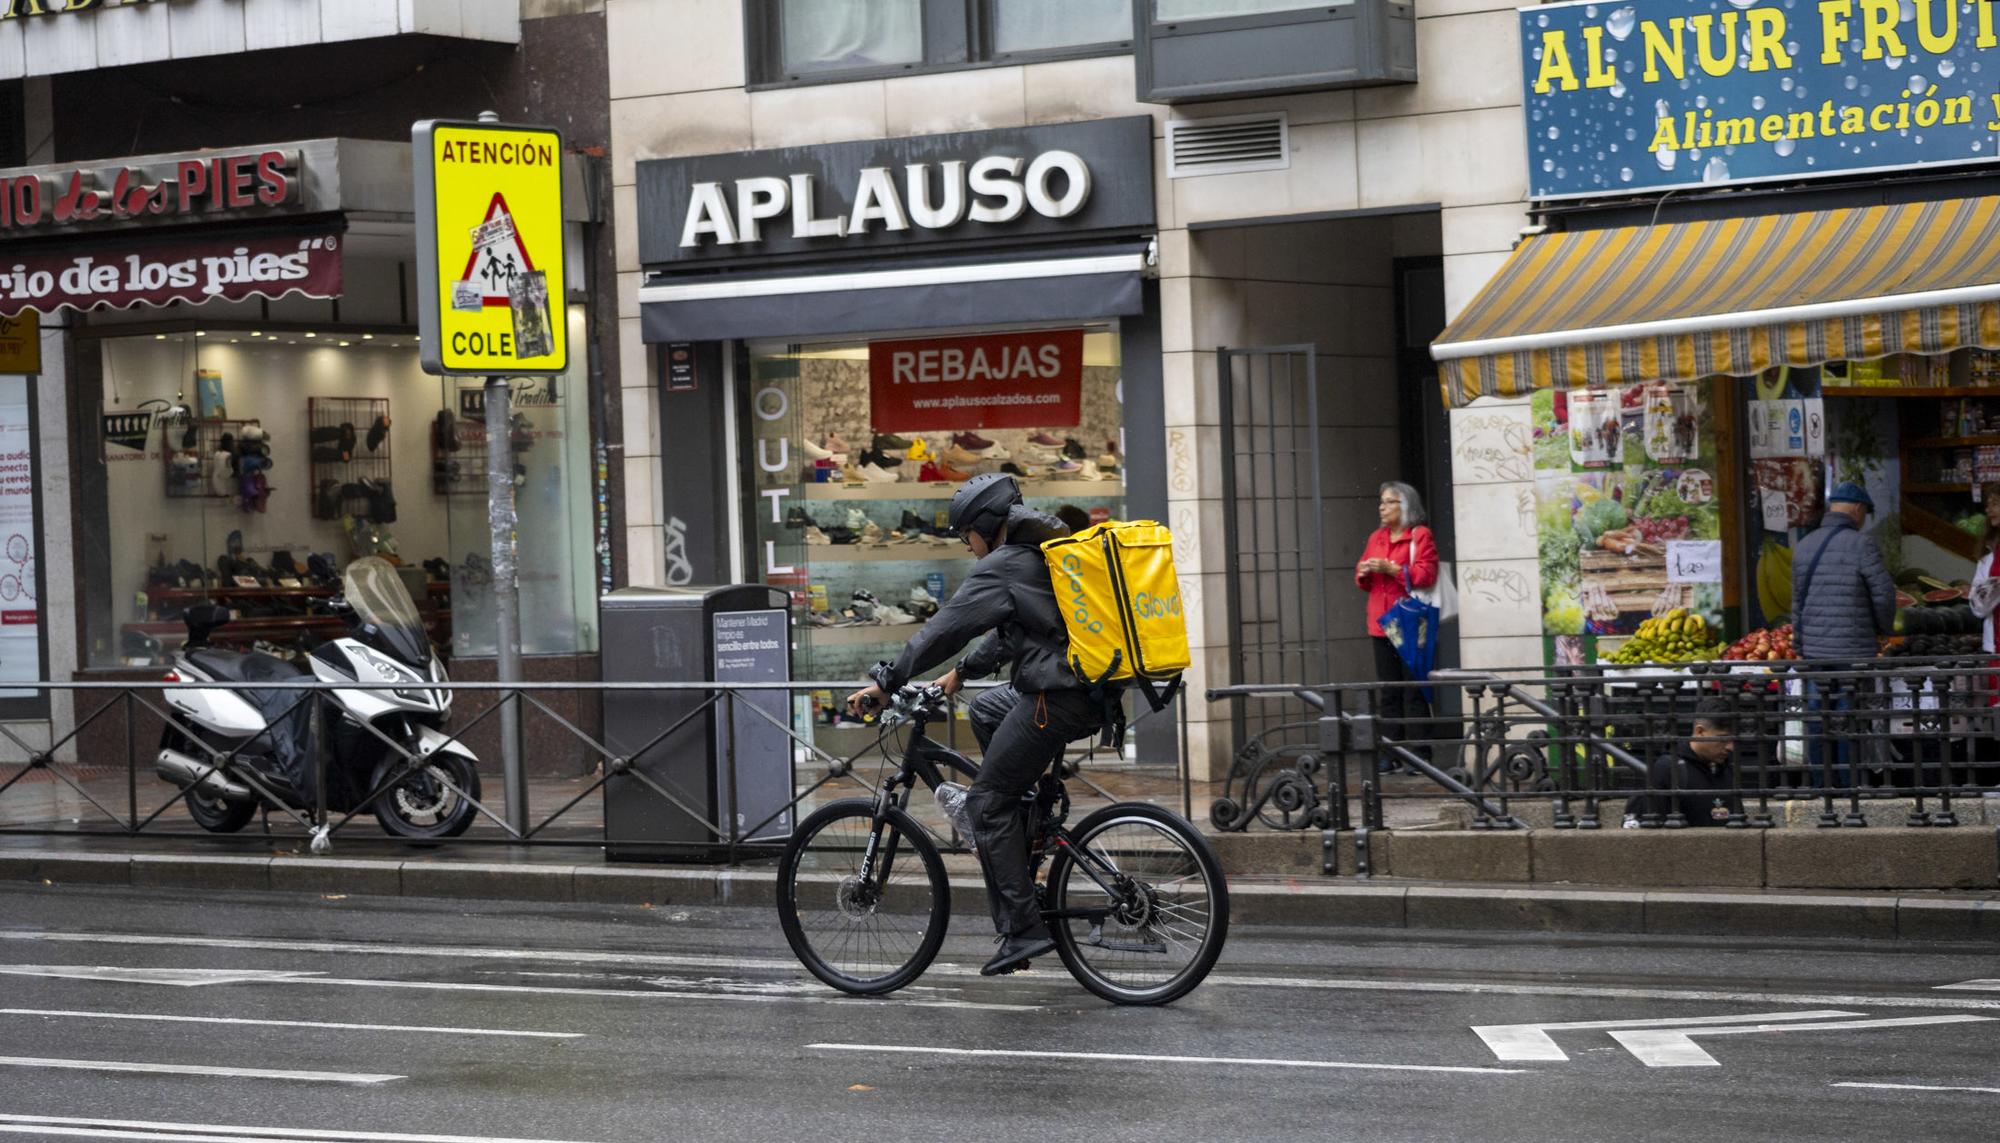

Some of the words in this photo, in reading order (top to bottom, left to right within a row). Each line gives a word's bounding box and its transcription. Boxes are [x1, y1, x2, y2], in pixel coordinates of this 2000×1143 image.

[1535, 26, 1616, 94] AL
[1641, 6, 1793, 83] NUR
[1647, 84, 1973, 153] Alimentación
[442, 138, 553, 167] ATENCIÓN
[177, 150, 289, 213] PIES
[679, 149, 1092, 248] APLAUSO
[59, 257, 121, 295] de
[124, 254, 198, 291] los
[452, 331, 513, 357] COLE
[892, 344, 1062, 384] REBAJAS
[913, 393, 1061, 409] www.aplausocalzados.com
[755, 387, 795, 575] OUTL
[1062, 553, 1089, 624] Glovo
[746, 616, 768, 627] Madrid
[718, 640, 742, 652] sencillo
[743, 641, 760, 650] entre
